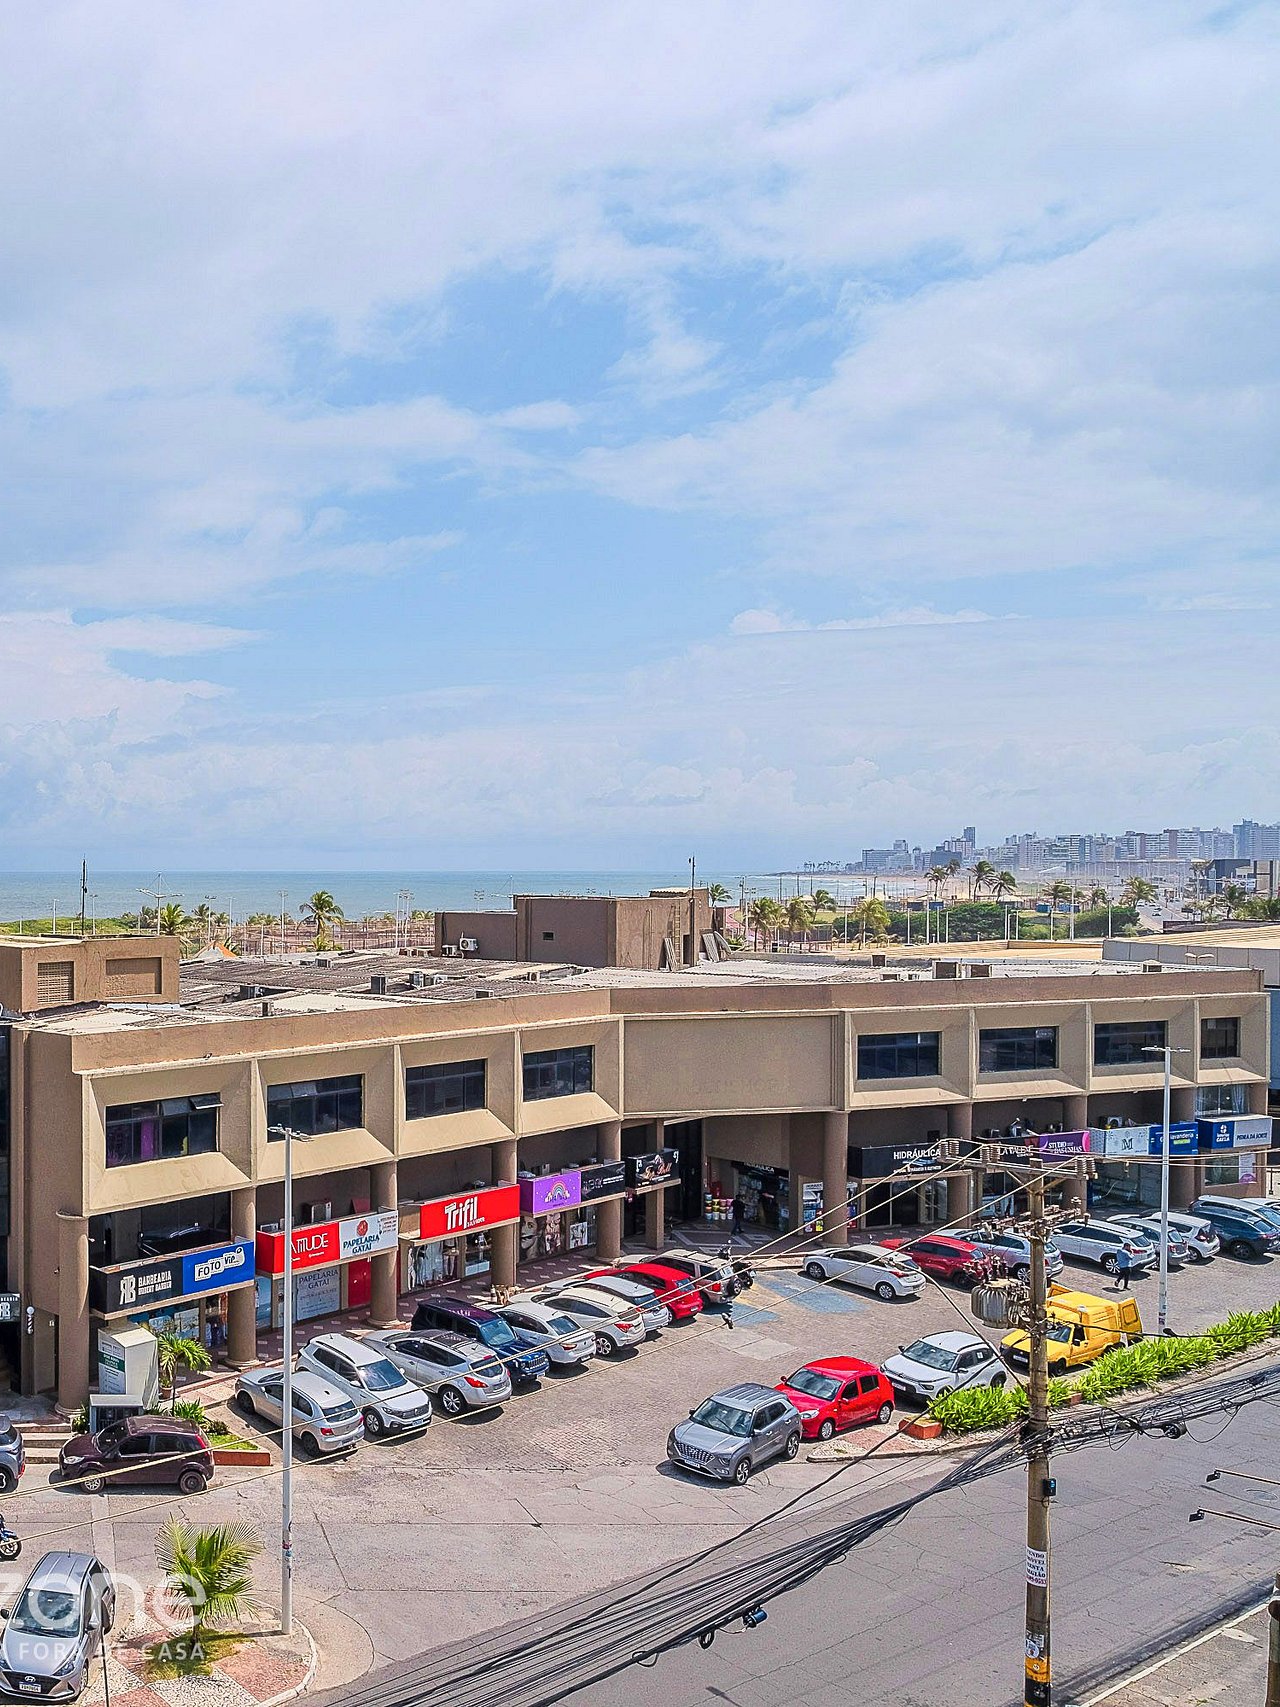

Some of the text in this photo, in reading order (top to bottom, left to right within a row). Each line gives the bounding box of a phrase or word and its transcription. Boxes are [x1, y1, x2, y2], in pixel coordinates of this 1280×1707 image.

[893, 1148, 942, 1160] HIDRÁULICA
[445, 1196, 478, 1231] Trifil
[343, 1234, 380, 1250] PAPELARIA
[198, 1260, 221, 1276] FOTO
[138, 1270, 172, 1288] BARBEARIA
[299, 1269, 339, 1285] PAPELARIA
